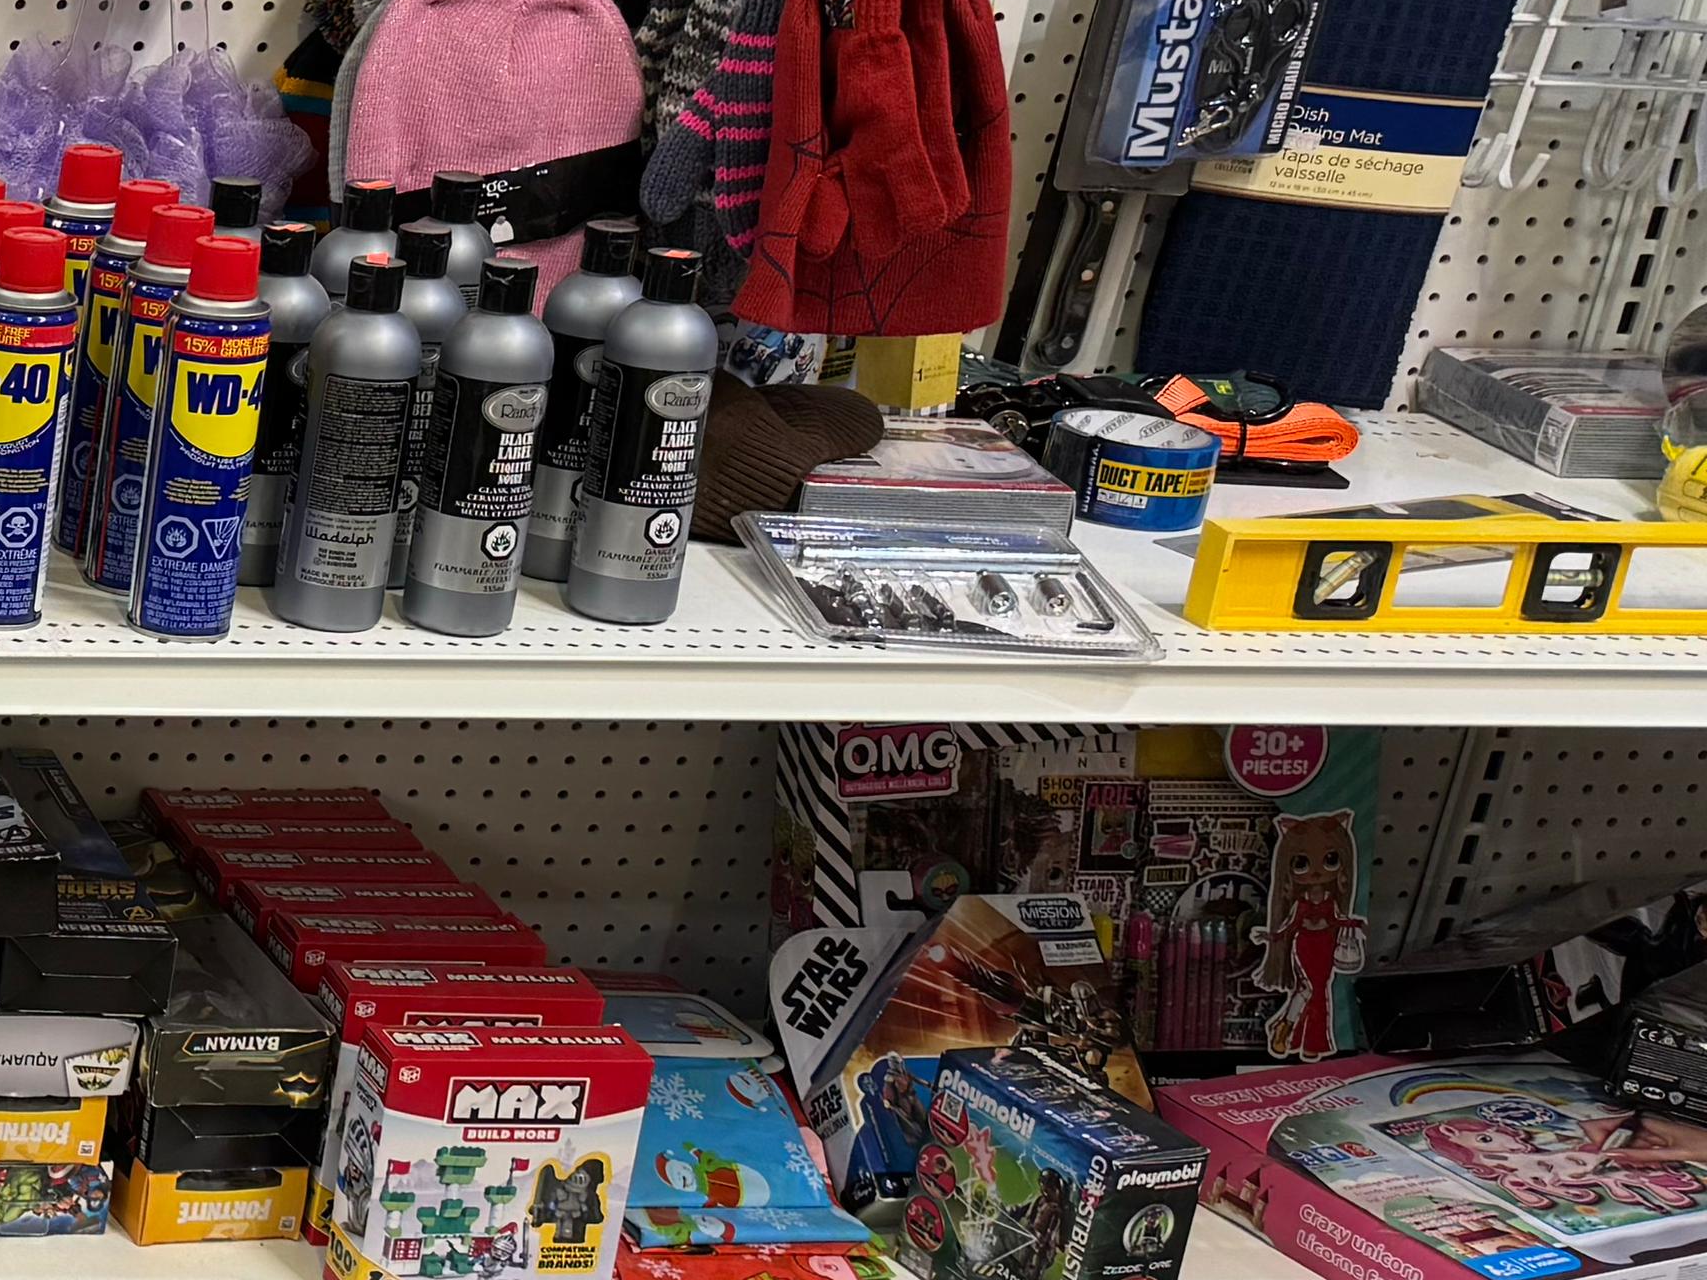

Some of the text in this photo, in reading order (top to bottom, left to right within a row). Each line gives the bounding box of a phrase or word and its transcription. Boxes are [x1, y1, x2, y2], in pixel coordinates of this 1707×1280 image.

[1291, 106, 1329, 122] Dish
[1281, 147, 1423, 175] Tapis de séchage
[1274, 166, 1345, 183] vaisselle
[663, 421, 698, 434] BLACK
[661, 434, 695, 447] LABEL
[498, 446, 532, 460] LABEL
[1099, 464, 1141, 489] DUCT
[1145, 473, 1184, 494] TAPE
[1251, 731, 1304, 756] 30+
[1243, 759, 1308, 775] PIECES!
[1021, 906, 1081, 920] MISSION
[782, 936, 850, 1025] STAR
[795, 946, 869, 1040] WARS
[205, 1033, 279, 1053] BATMAN
[393, 1032, 473, 1044] MAX
[543, 1037, 621, 1045] VALUE!
[453, 1085, 581, 1119] MAX
[939, 1070, 1035, 1138] playmobil
[467, 1129, 556, 1140] BUILD MORE
[1117, 1163, 1202, 1190] playmobil
[177, 1198, 271, 1224] FORTNITE
[1299, 1204, 1349, 1244] Crazy
[537, 1260, 593, 1268] BRANDS!
[1297, 1232, 1364, 1280] Licorne
